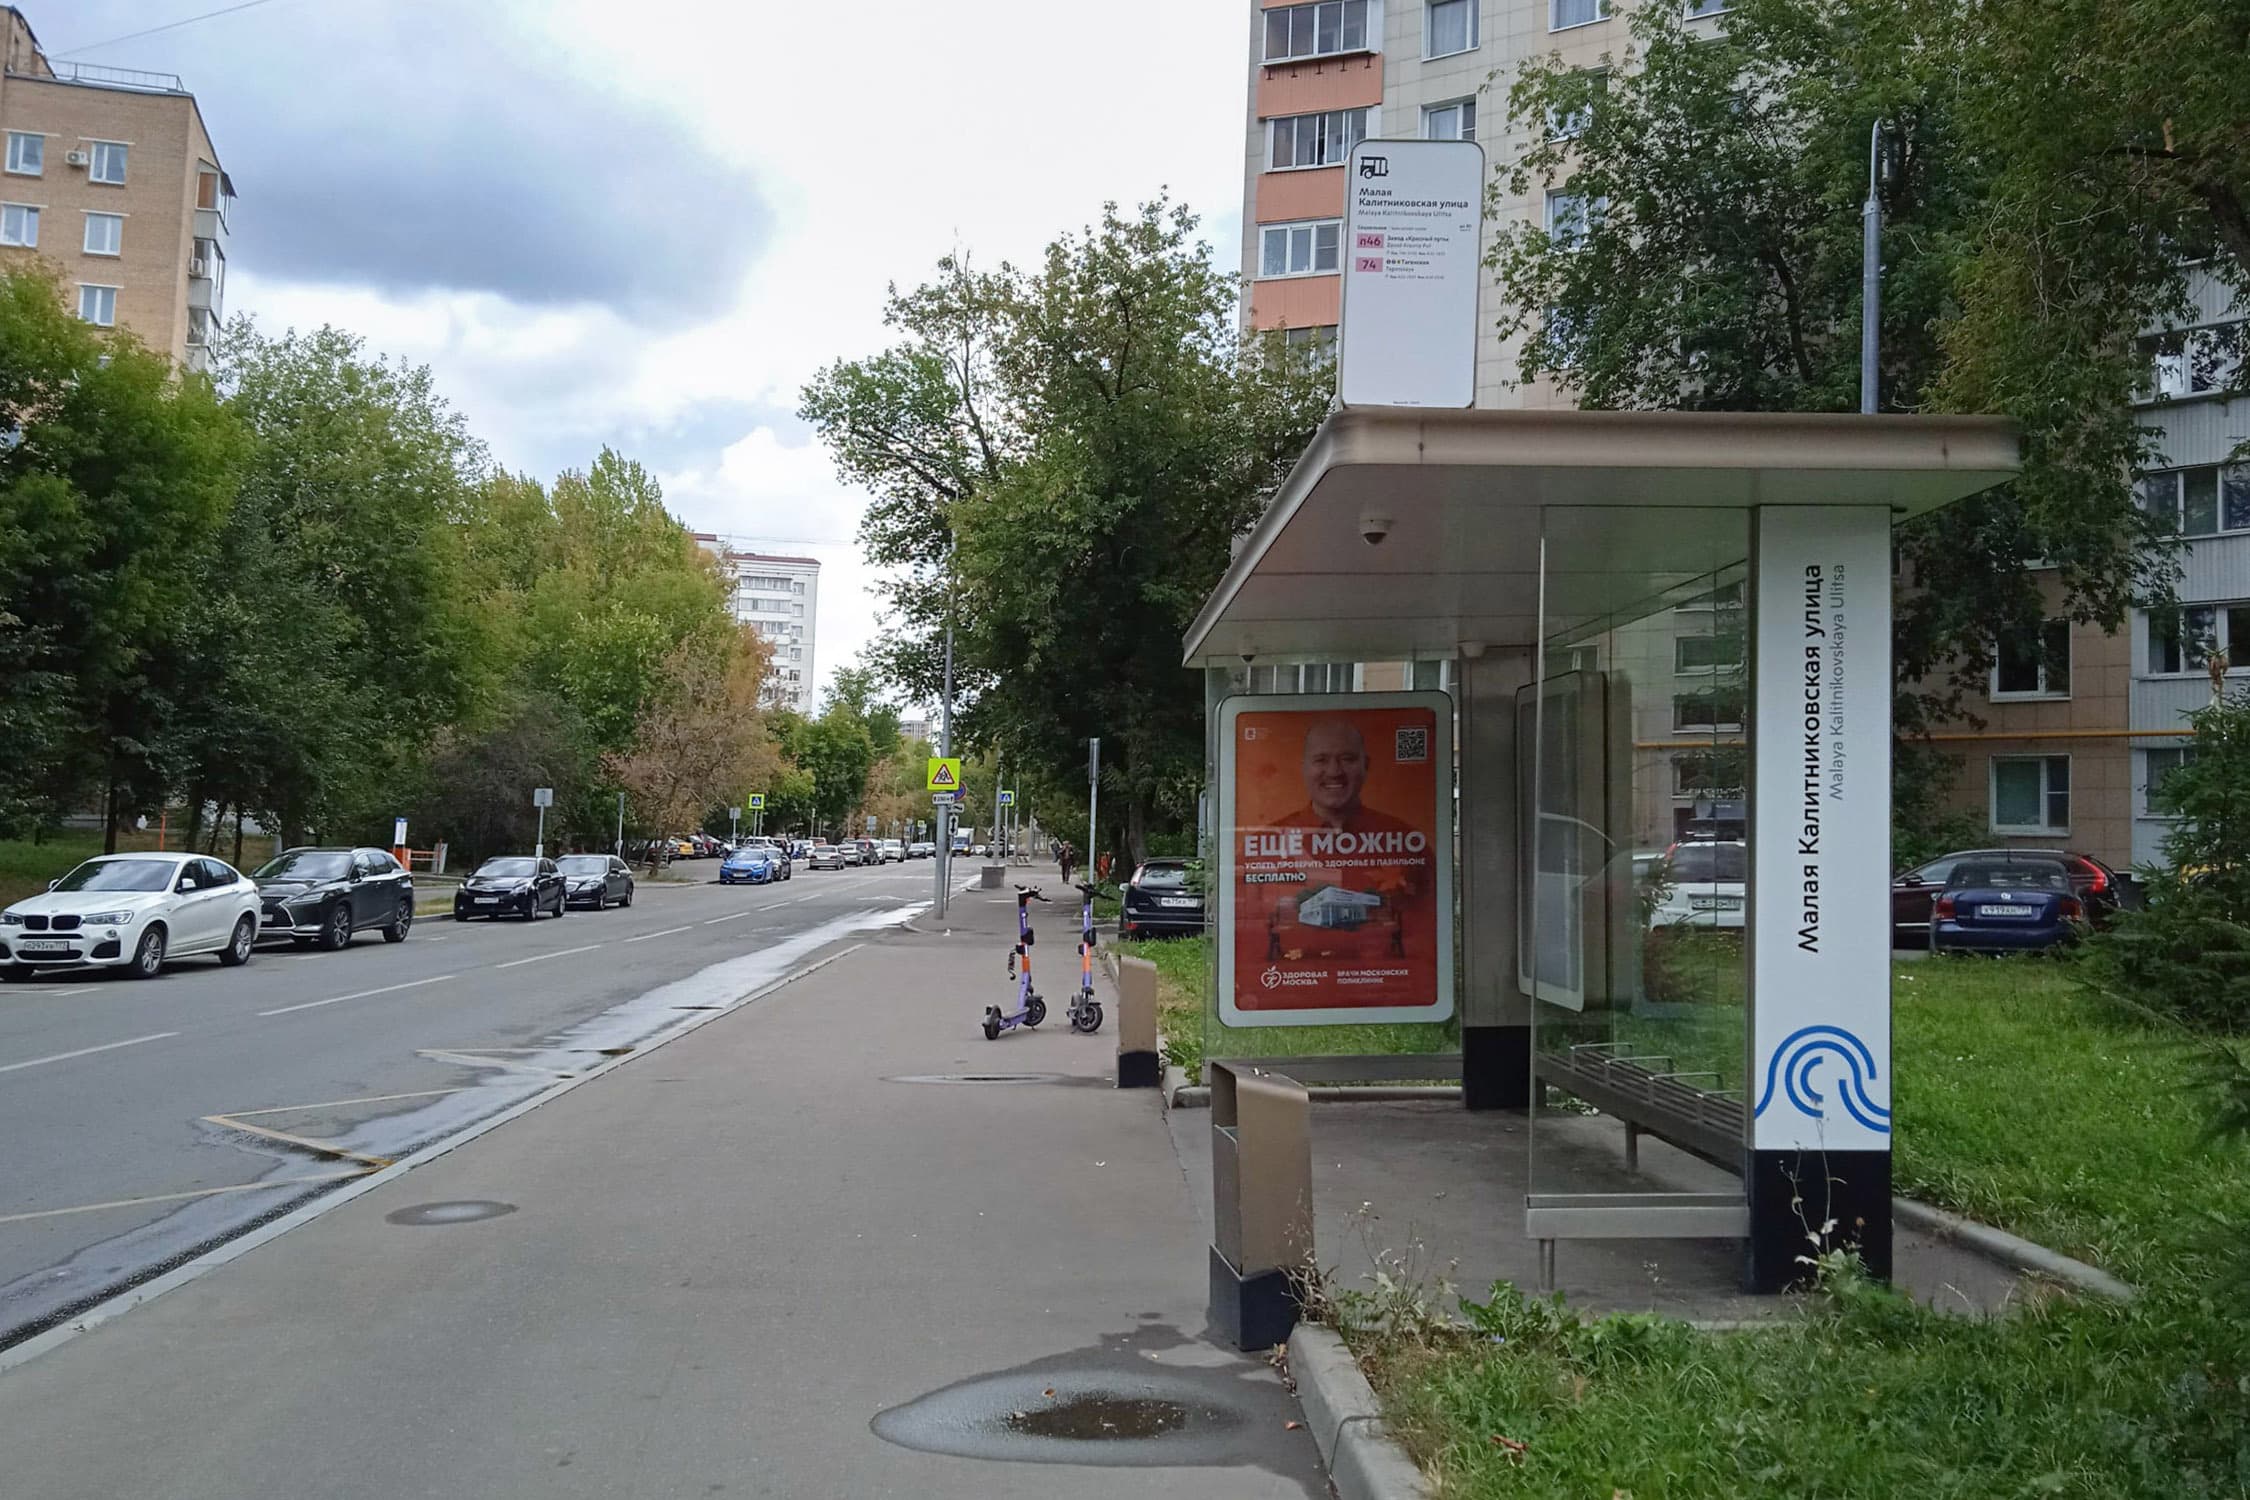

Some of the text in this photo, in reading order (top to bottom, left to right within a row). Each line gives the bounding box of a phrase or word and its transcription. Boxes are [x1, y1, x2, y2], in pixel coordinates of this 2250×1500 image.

[1359, 187, 1392, 197] Малая
[1359, 198, 1469, 210] Калитниковская улица
[1362, 259, 1377, 270] 74
[1829, 565, 1847, 800] Malaya Kalitnikovskaya Ulitsa
[1798, 565, 1826, 954] Малая Калитниковская улица
[1244, 831, 1426, 859] ЕЩЁ МОЖНО
[1325, 859, 1368, 868] ЗДОРОВЬЕ
[1376, 858, 1425, 866] ПАВИЛЬОНЕ
[1245, 872, 1307, 883] БЕСПЛАТНО
